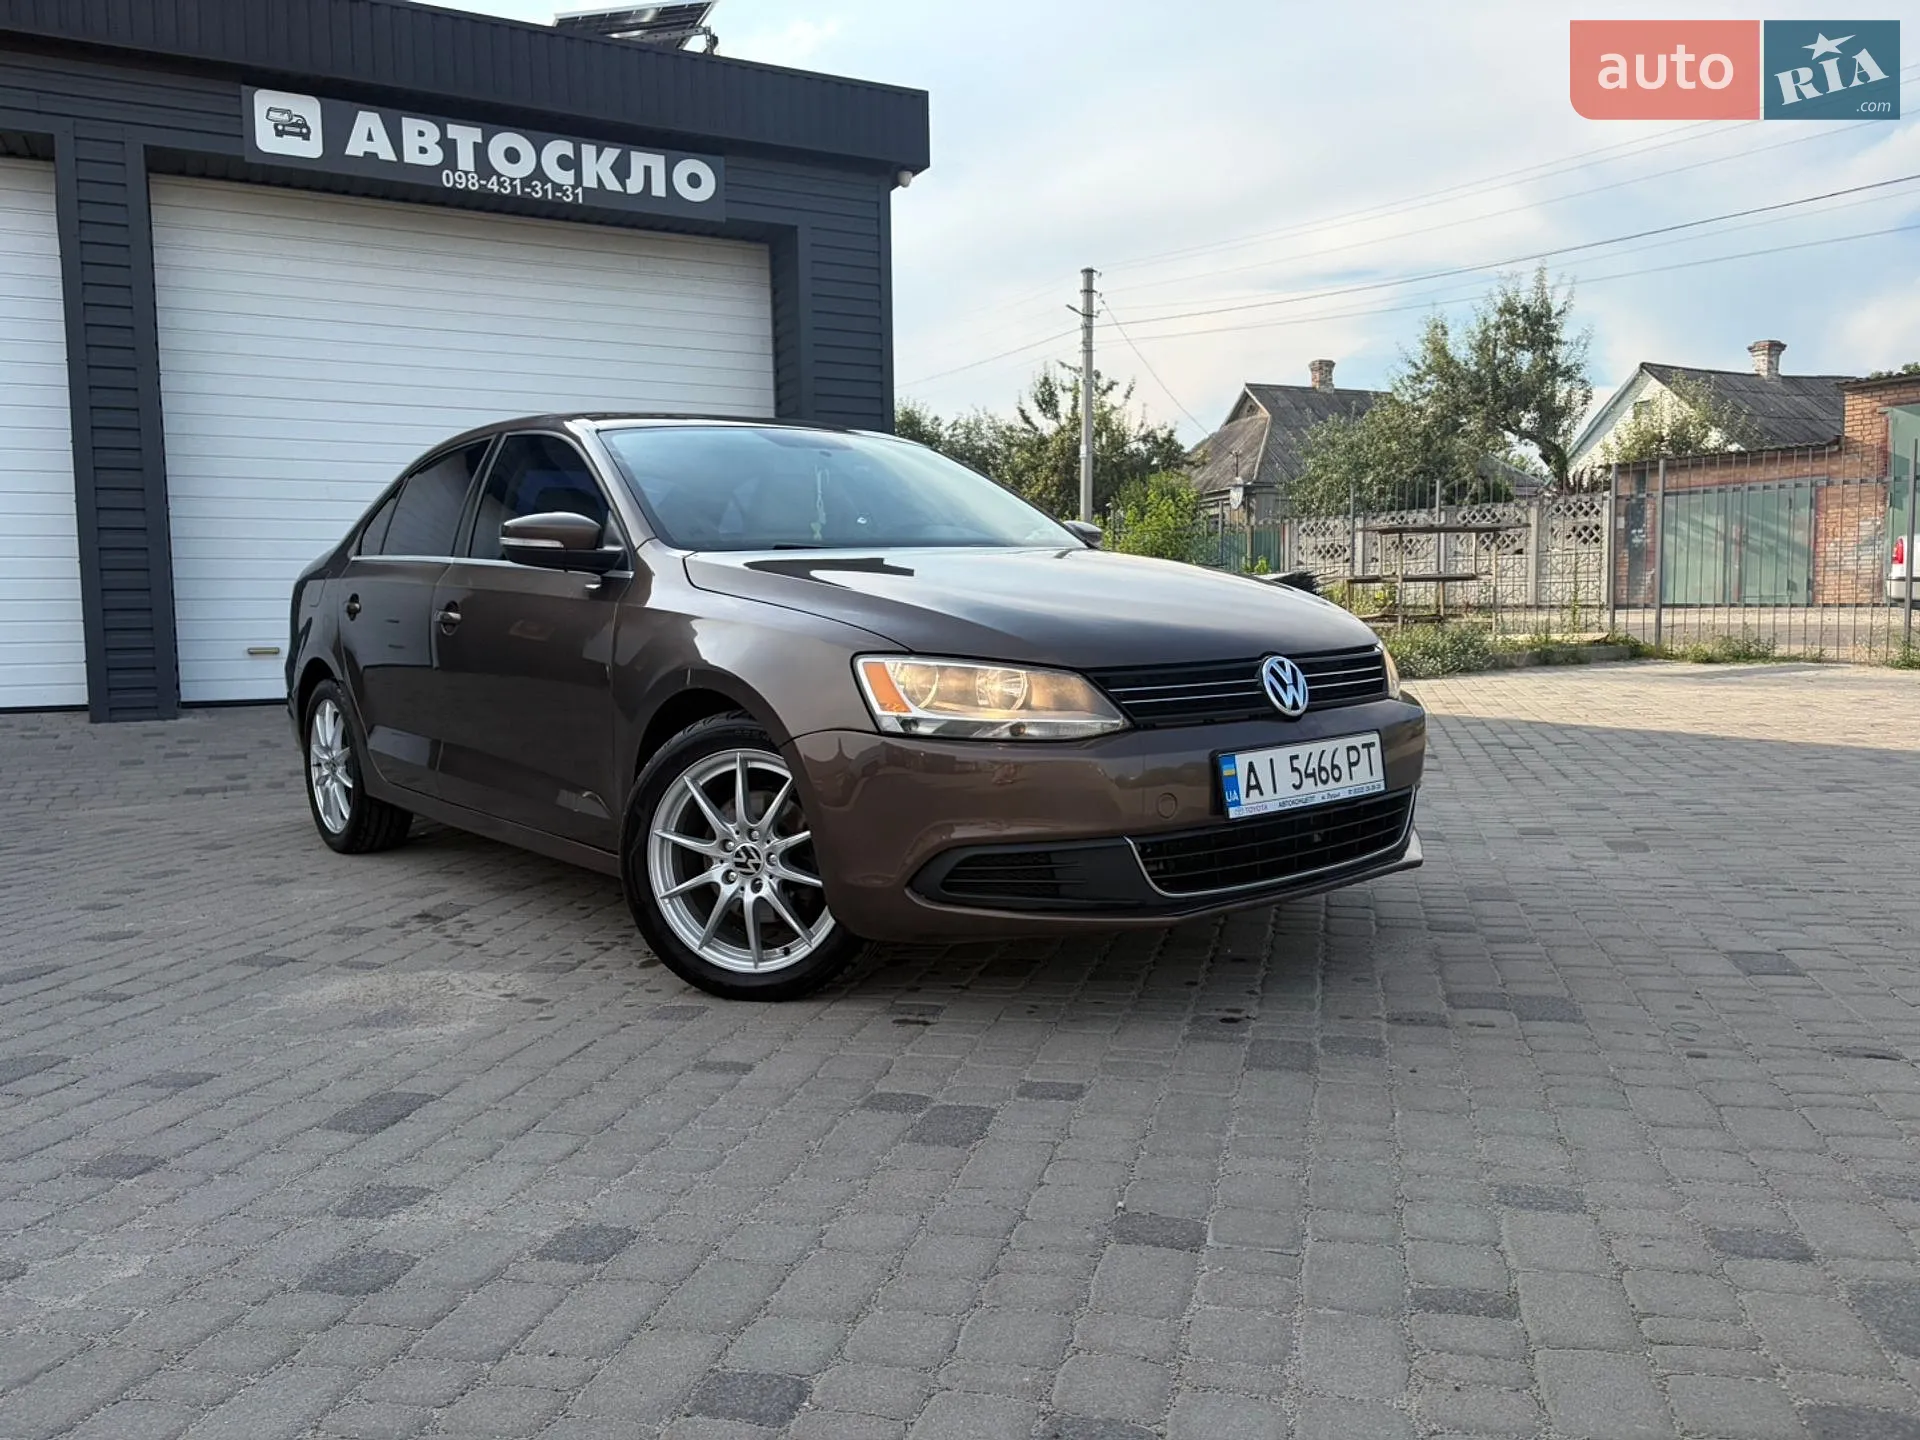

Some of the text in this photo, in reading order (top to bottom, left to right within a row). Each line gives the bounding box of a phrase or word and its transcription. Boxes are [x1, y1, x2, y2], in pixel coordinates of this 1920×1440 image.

[345, 110, 716, 203] АВТОСКЛО
[441, 169, 584, 204] 098-431-31-31
[1246, 742, 1376, 799] AI 5466 PT
[1226, 790, 1239, 802] UA
